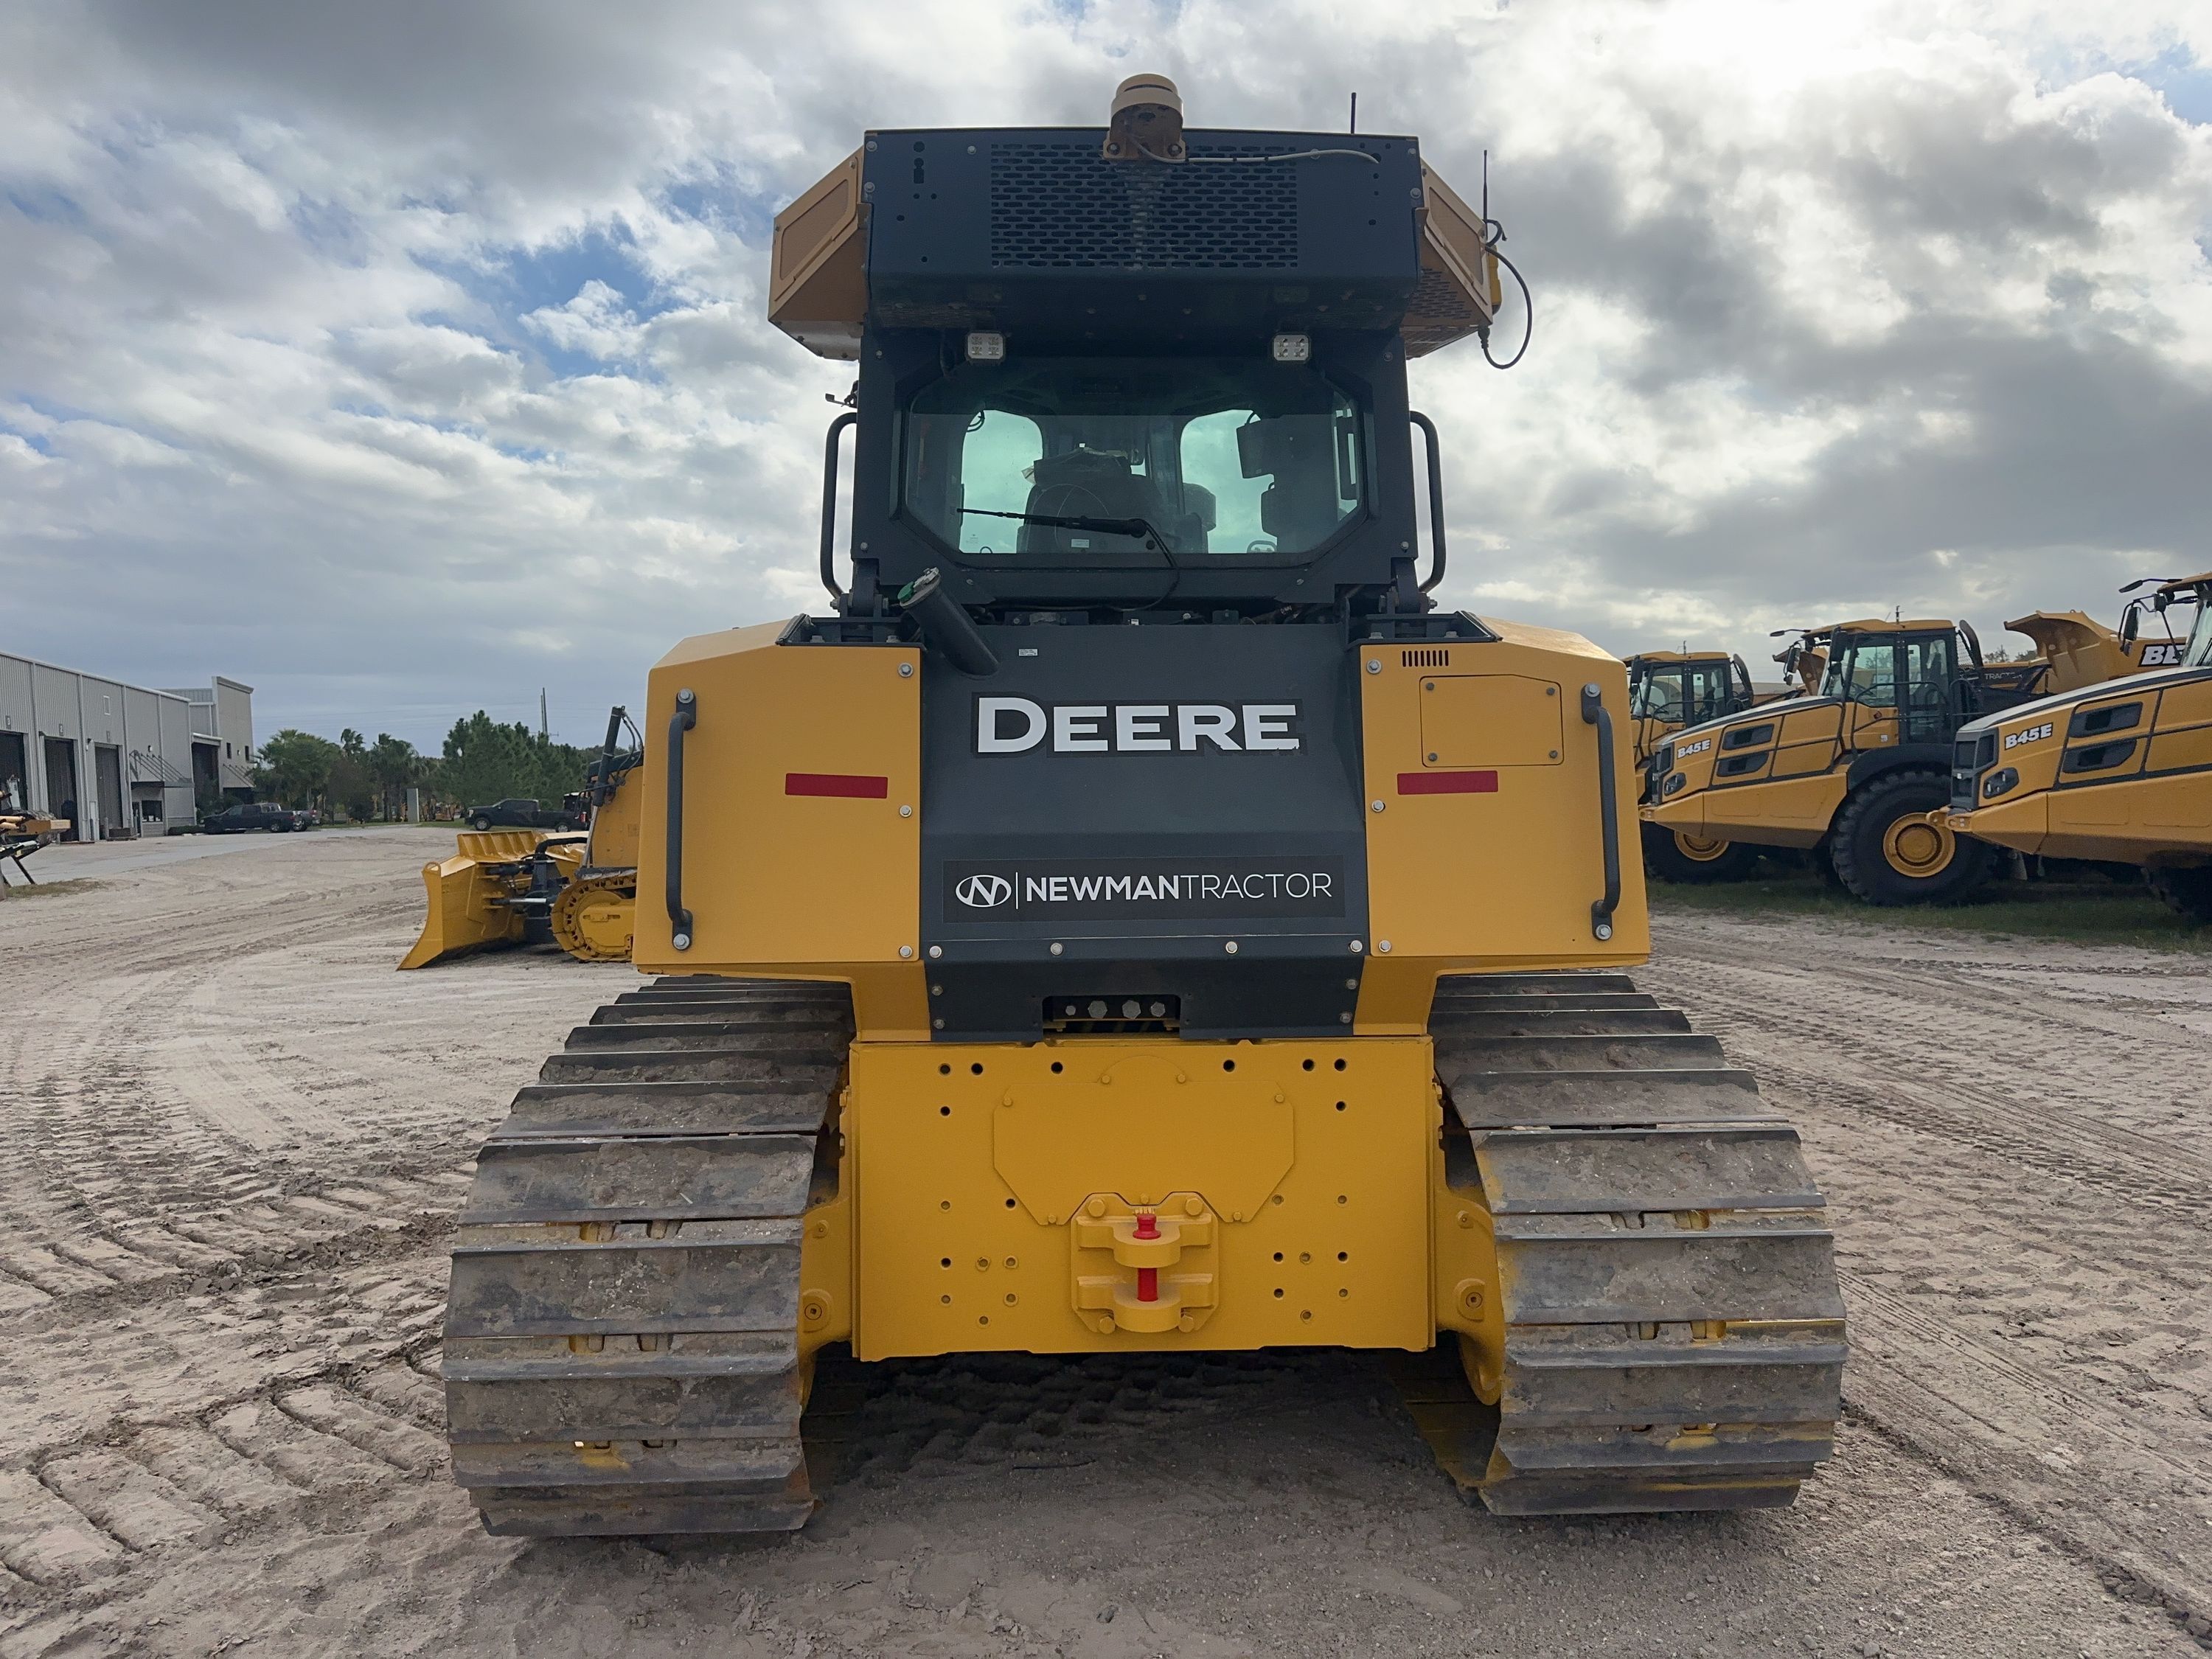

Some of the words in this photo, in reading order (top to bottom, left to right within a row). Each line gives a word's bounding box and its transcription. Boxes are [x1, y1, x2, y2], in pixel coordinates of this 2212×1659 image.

[978, 697, 1300, 753] DEERE
[2005, 723, 2053, 750] B45E
[1677, 739, 1711, 759] B45E
